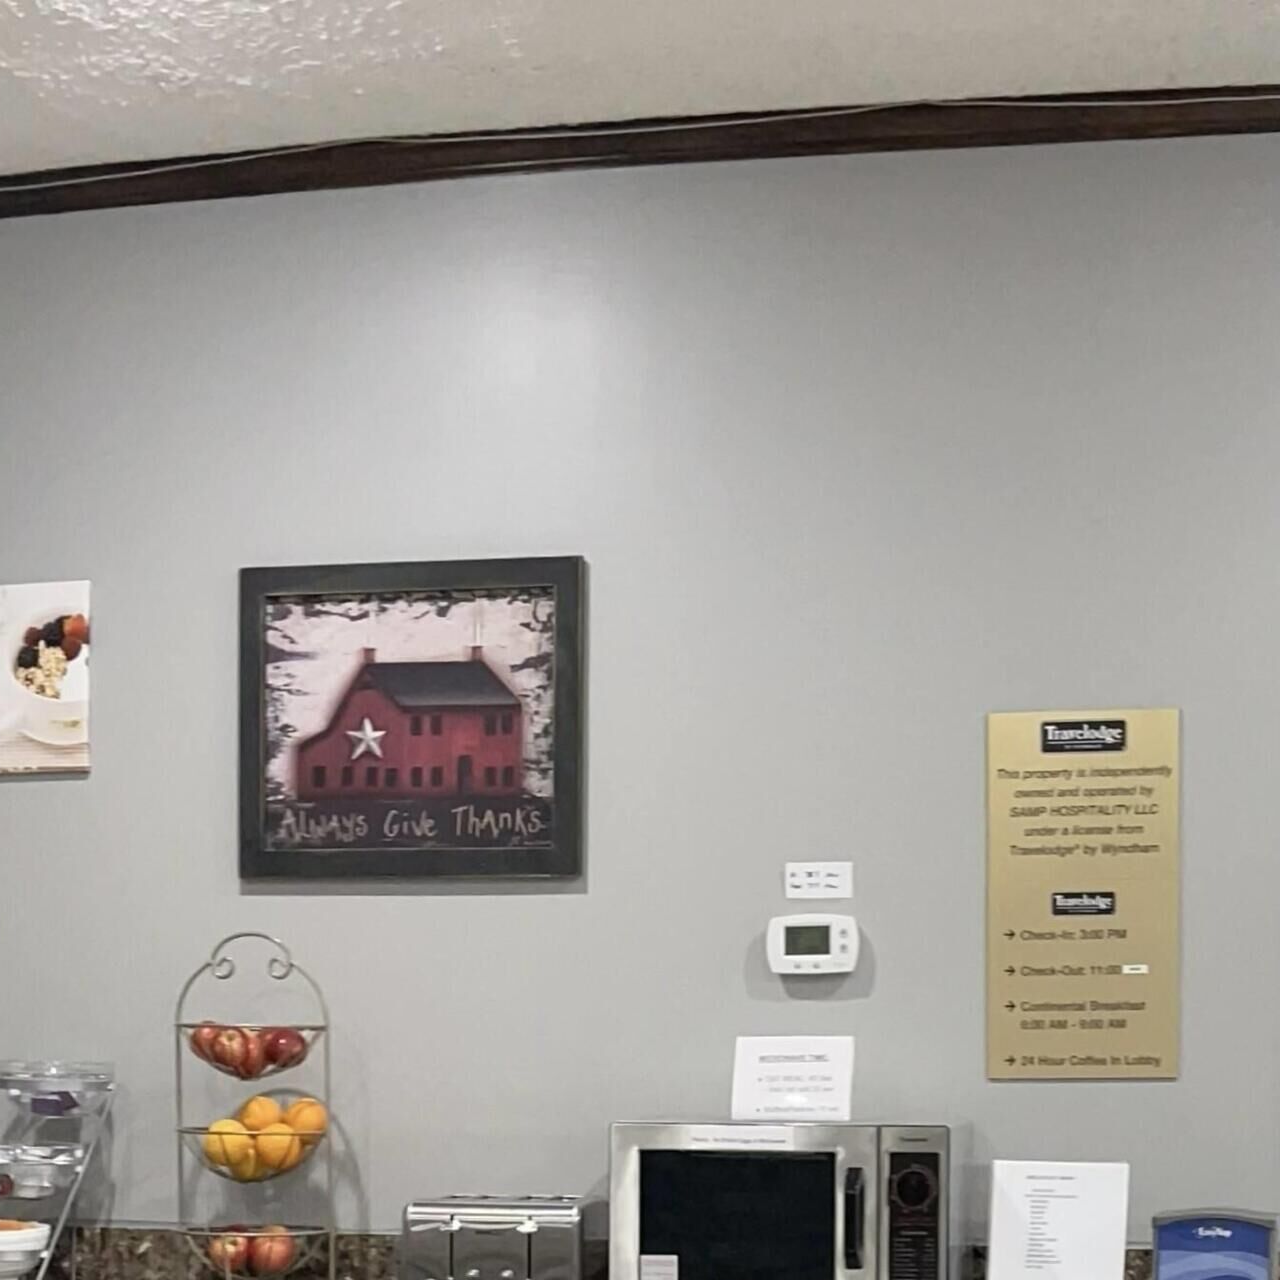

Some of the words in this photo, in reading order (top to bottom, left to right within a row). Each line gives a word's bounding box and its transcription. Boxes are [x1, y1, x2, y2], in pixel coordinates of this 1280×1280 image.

[1043, 723, 1123, 743] Travelodge
[1049, 804, 1131, 817] HOSPITALITY
[1133, 803, 1159, 815] LLC
[383, 809, 438, 838] Give
[1107, 928, 1128, 939] PM
[1069, 1055, 1107, 1066] Coffee
[1124, 1055, 1162, 1068] Lobby
